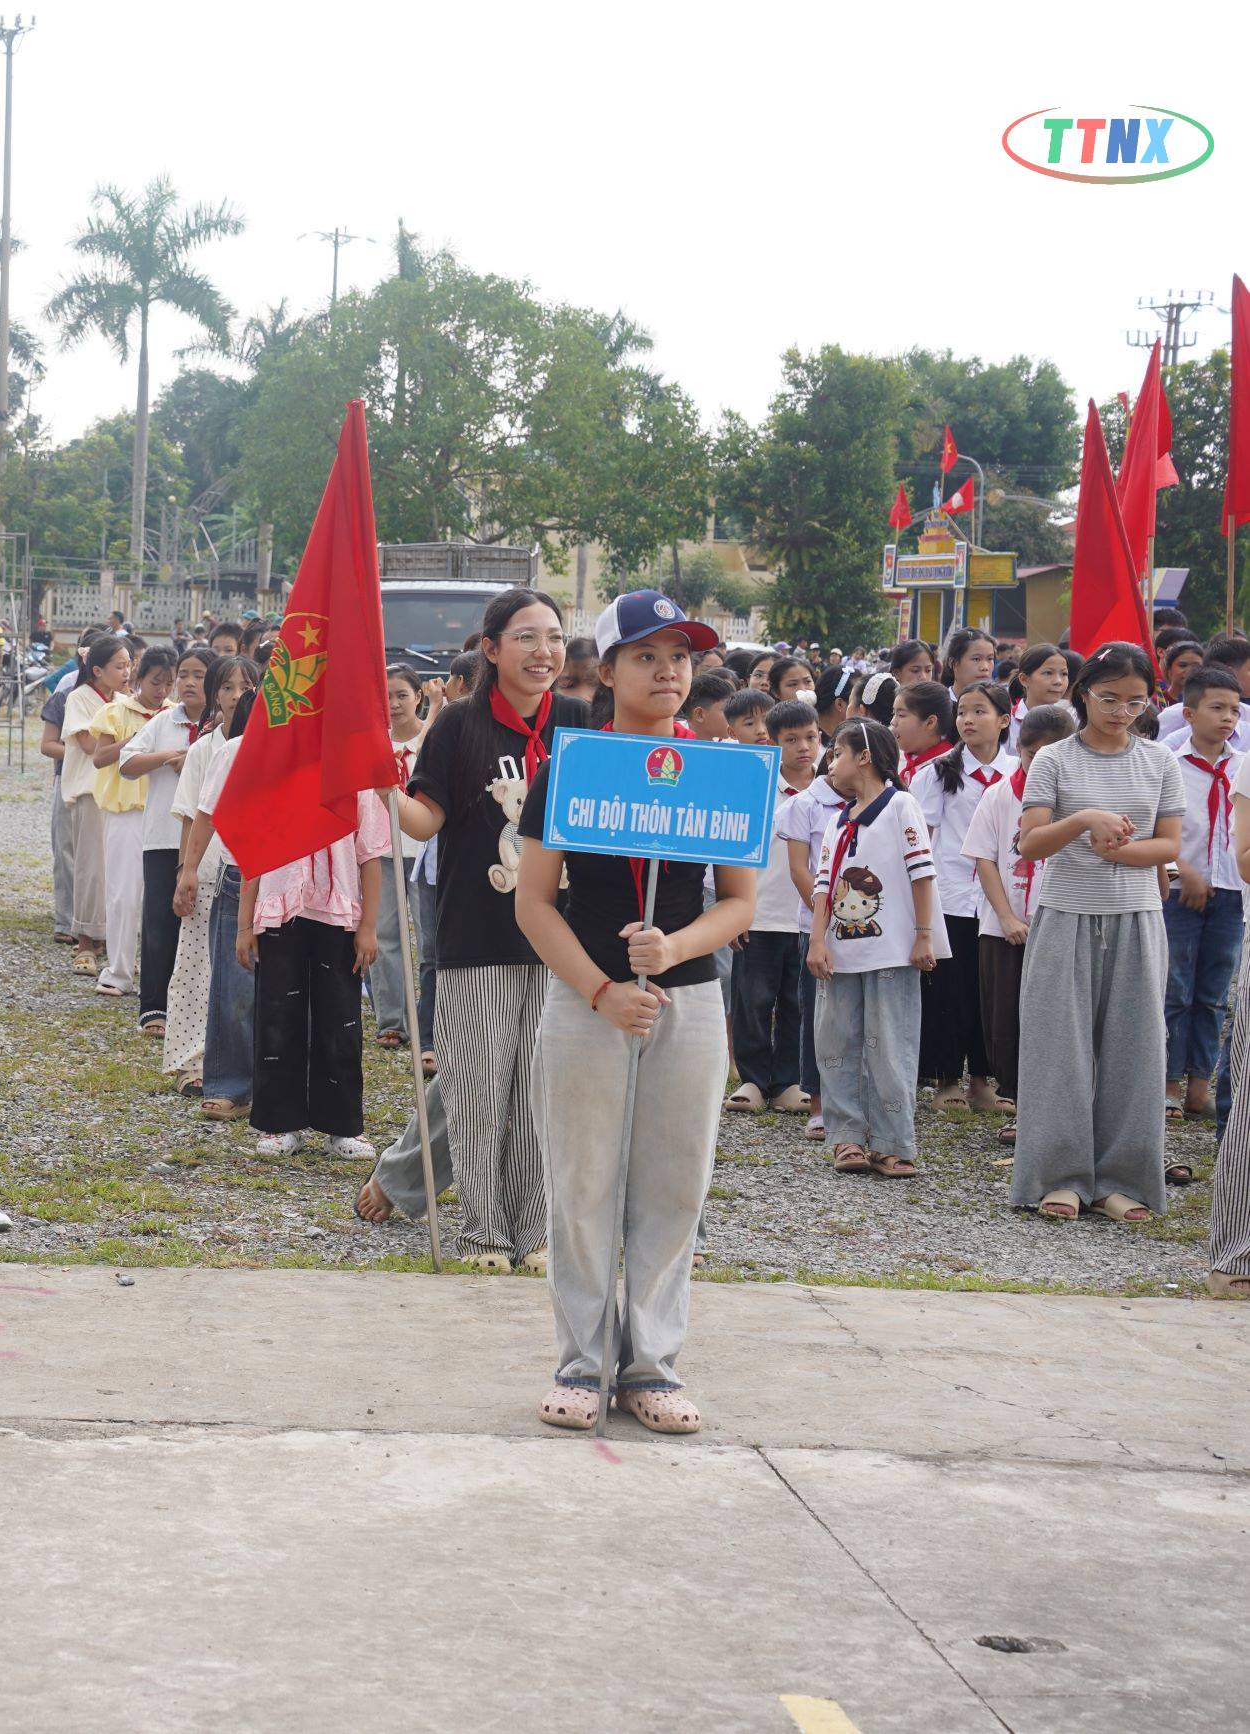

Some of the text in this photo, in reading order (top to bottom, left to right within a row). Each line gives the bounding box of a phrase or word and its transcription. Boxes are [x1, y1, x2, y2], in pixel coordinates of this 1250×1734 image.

[568, 794, 750, 842] CHI ĐỘI THÔN TÂN BÌNH
